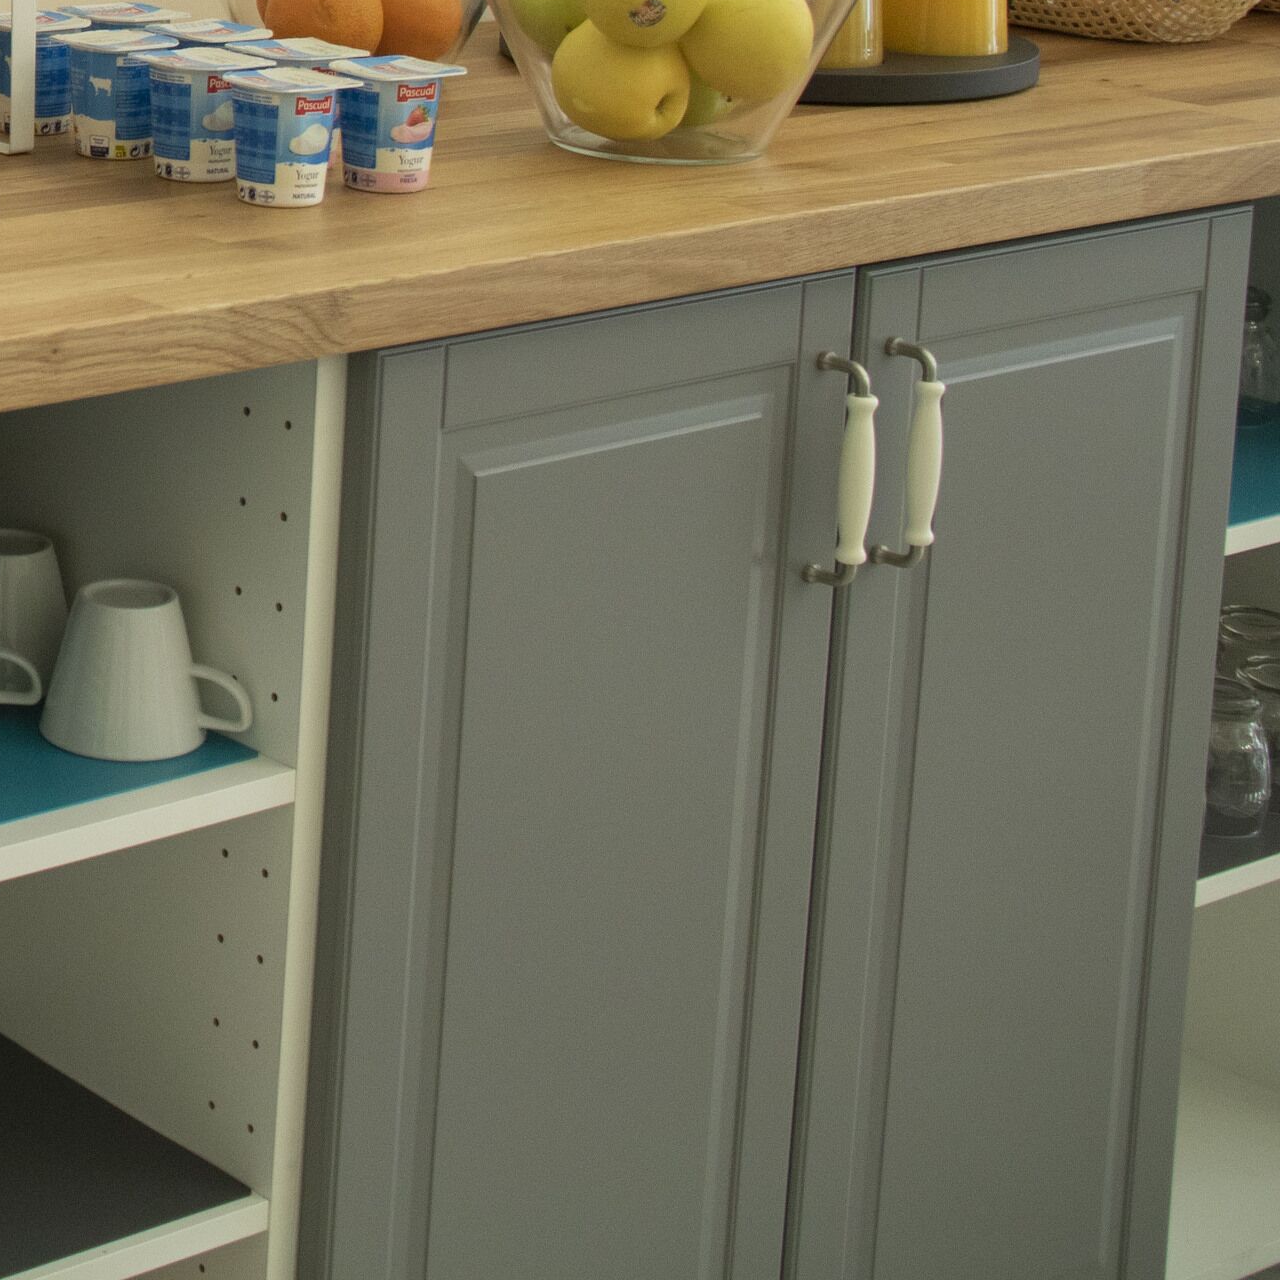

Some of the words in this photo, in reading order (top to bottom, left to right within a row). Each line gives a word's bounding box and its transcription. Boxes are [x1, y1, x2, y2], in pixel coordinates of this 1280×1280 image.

[209, 78, 231, 89] Pasc
[400, 86, 434, 97] Pascual
[297, 99, 330, 110] Pascual
[399, 155, 424, 168] Yogur
[296, 169, 320, 183] Yogur
